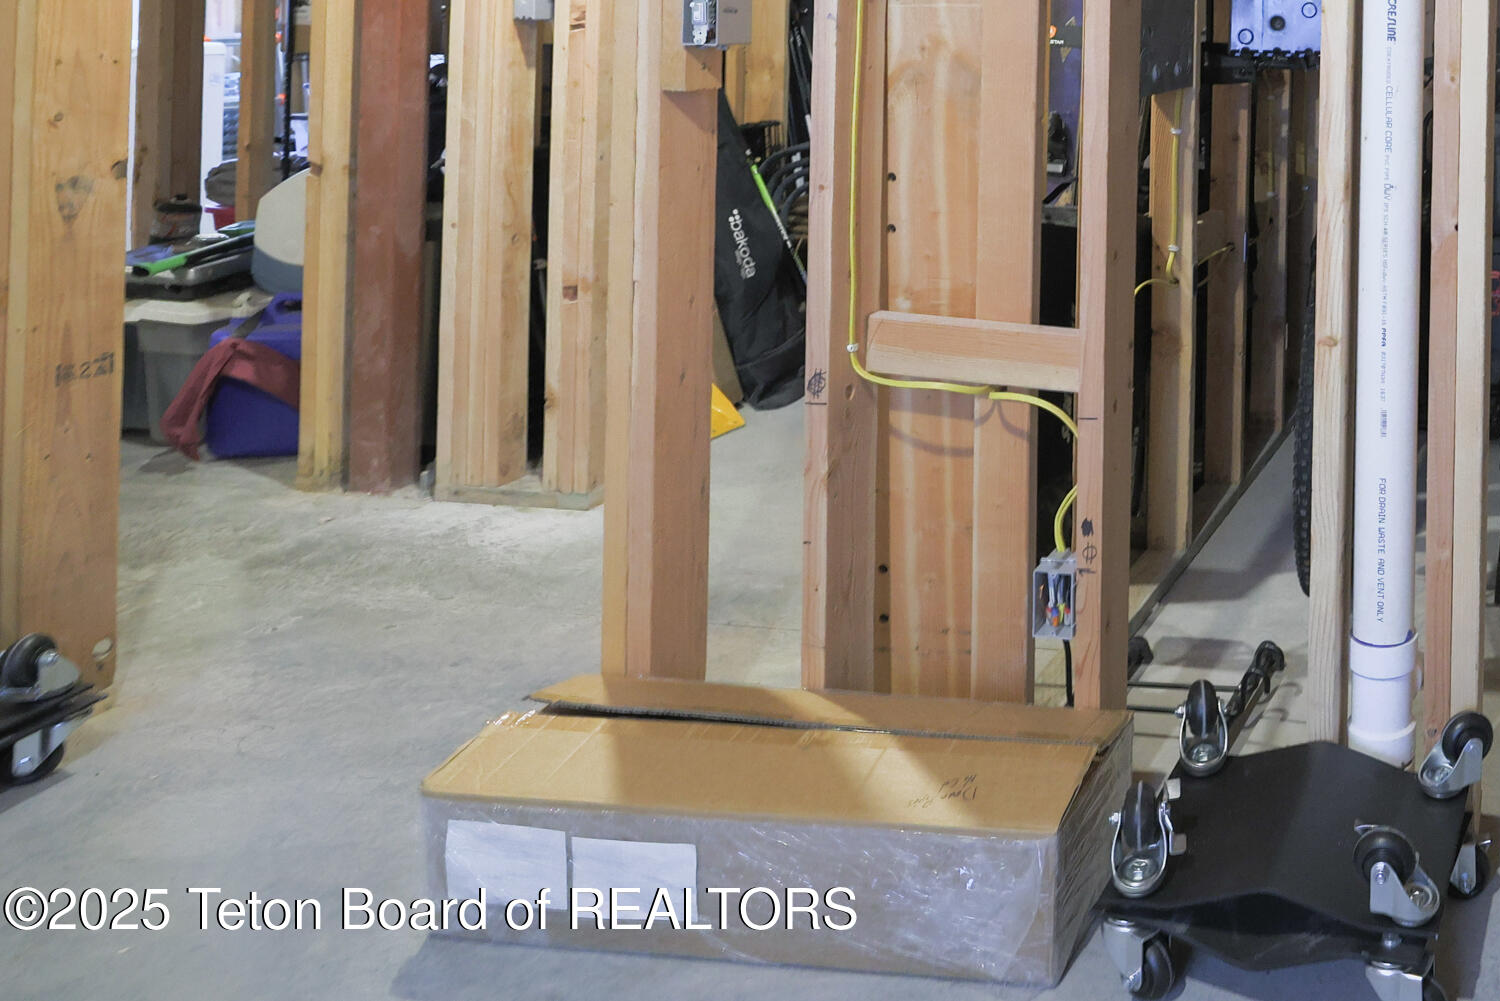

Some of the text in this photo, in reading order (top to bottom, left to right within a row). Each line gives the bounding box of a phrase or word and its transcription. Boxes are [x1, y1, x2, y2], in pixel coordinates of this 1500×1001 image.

[1384, 85, 1394, 128] CELLULAR
[1384, 130, 1393, 154] CORE
[1383, 182, 1392, 200] DWV
[730, 218, 756, 279] bakoda
[1376, 478, 1386, 622] FOR DRAIN WASTE AND VENT ONLY
